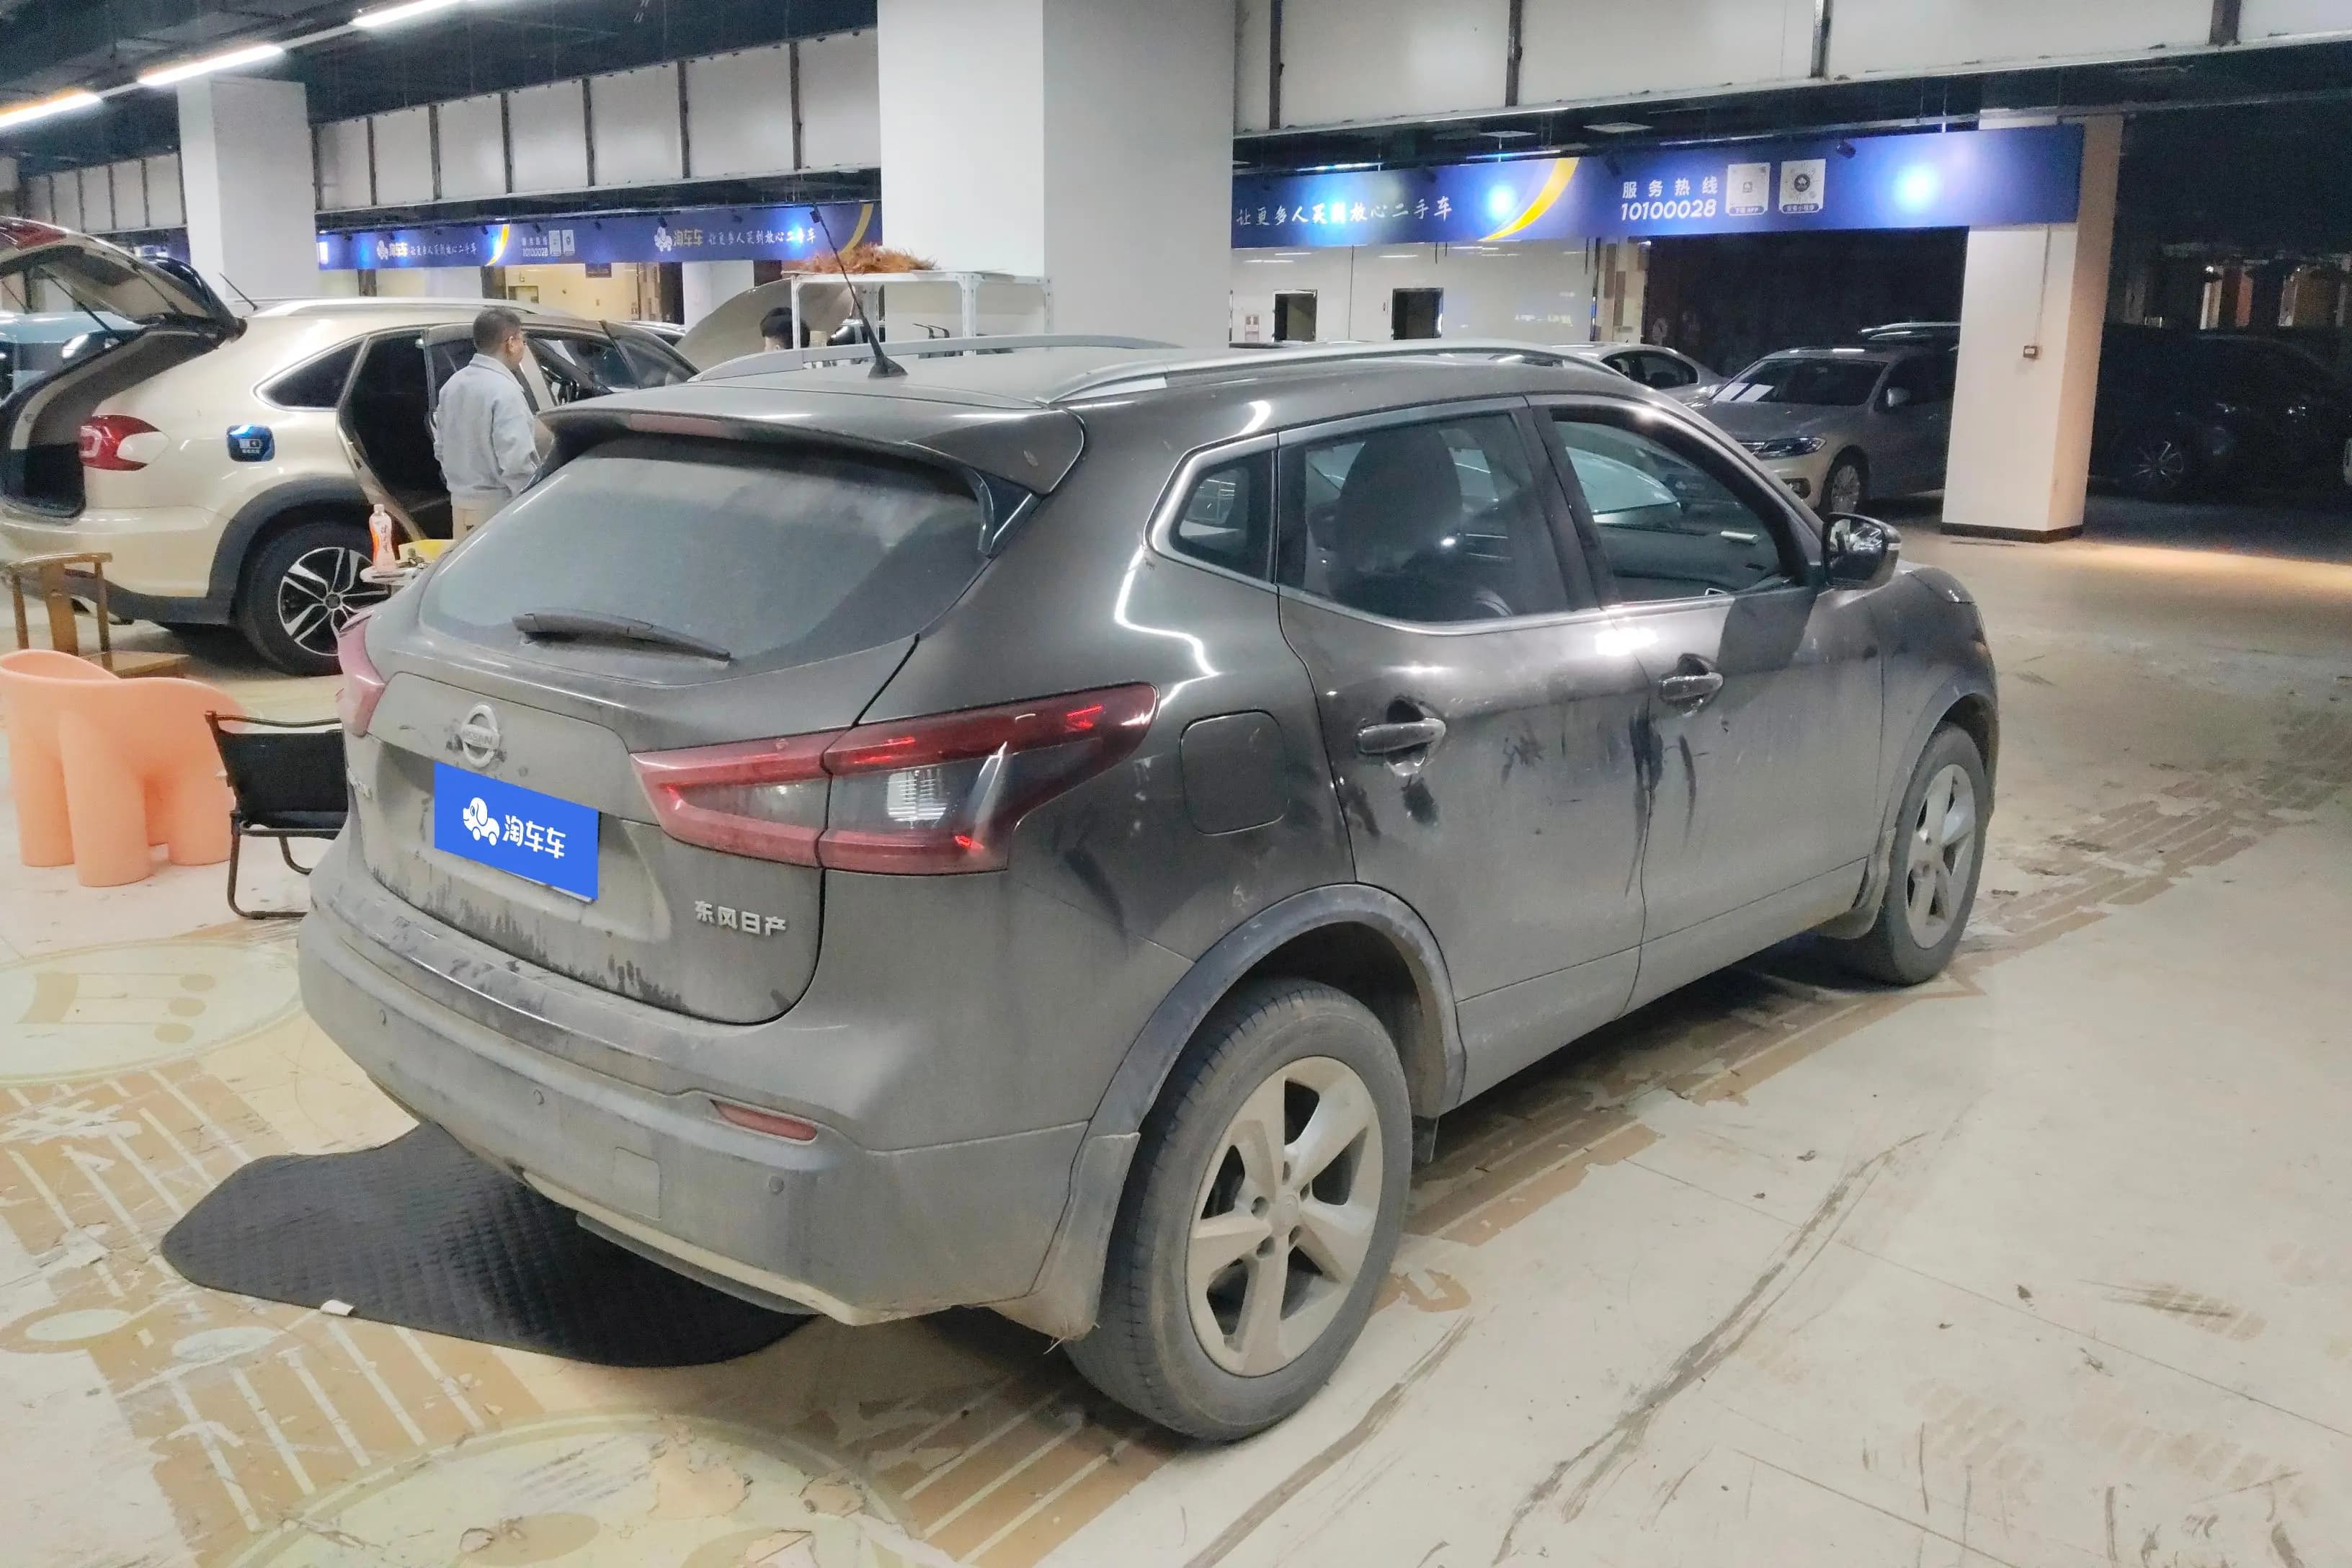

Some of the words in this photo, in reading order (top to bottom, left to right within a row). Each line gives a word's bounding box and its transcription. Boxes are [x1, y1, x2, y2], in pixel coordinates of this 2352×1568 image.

[1622, 177, 1718, 199] 服务热线
[1237, 195, 1452, 226] 让更多人买放心二手车
[1621, 199, 1717, 220] 10100028
[695, 901, 786, 936] 东风日产
